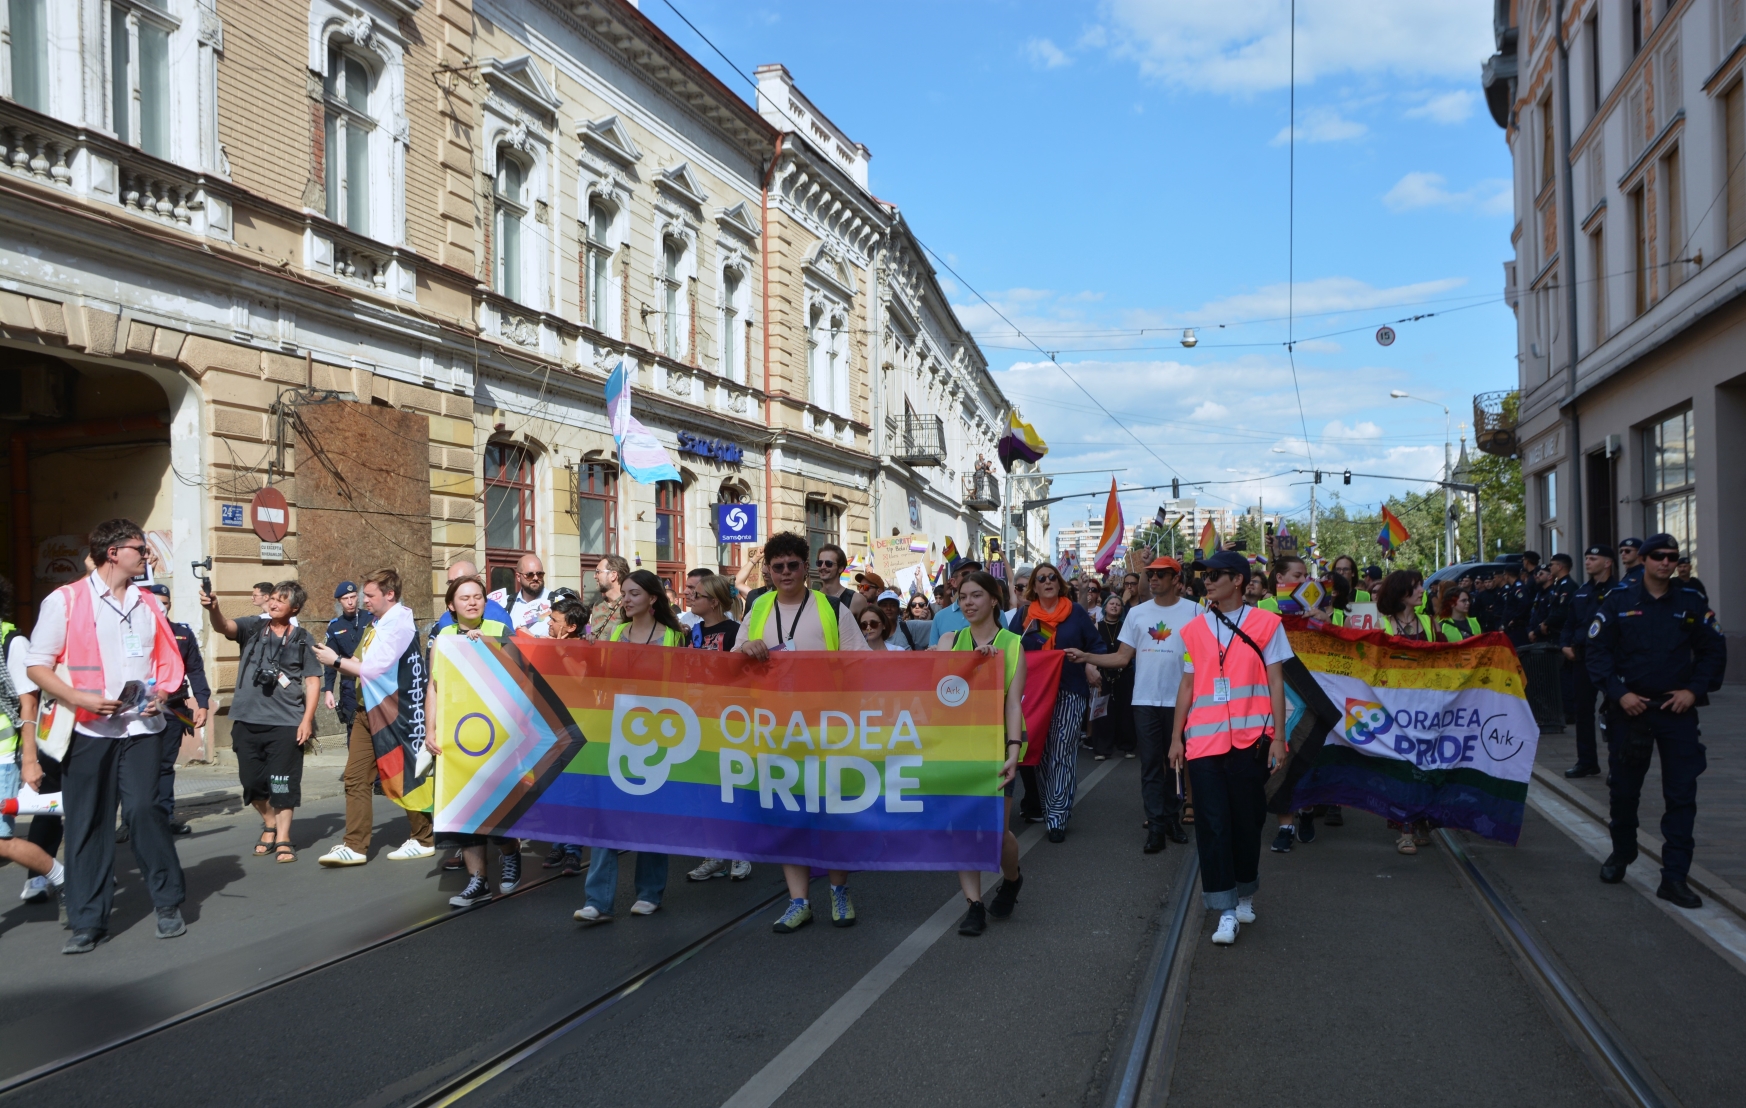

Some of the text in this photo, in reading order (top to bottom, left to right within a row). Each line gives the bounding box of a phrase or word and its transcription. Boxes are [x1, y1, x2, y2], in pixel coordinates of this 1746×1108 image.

[1380, 331, 1390, 340] 15
[222, 507, 232, 517] 24
[945, 686, 961, 695] Ark
[719, 704, 923, 750] ORADEA
[1394, 708, 1482, 731] ORADEA
[1488, 728, 1514, 746] Ark
[1393, 734, 1479, 766] PRIDE
[719, 747, 924, 814] PRIDE
